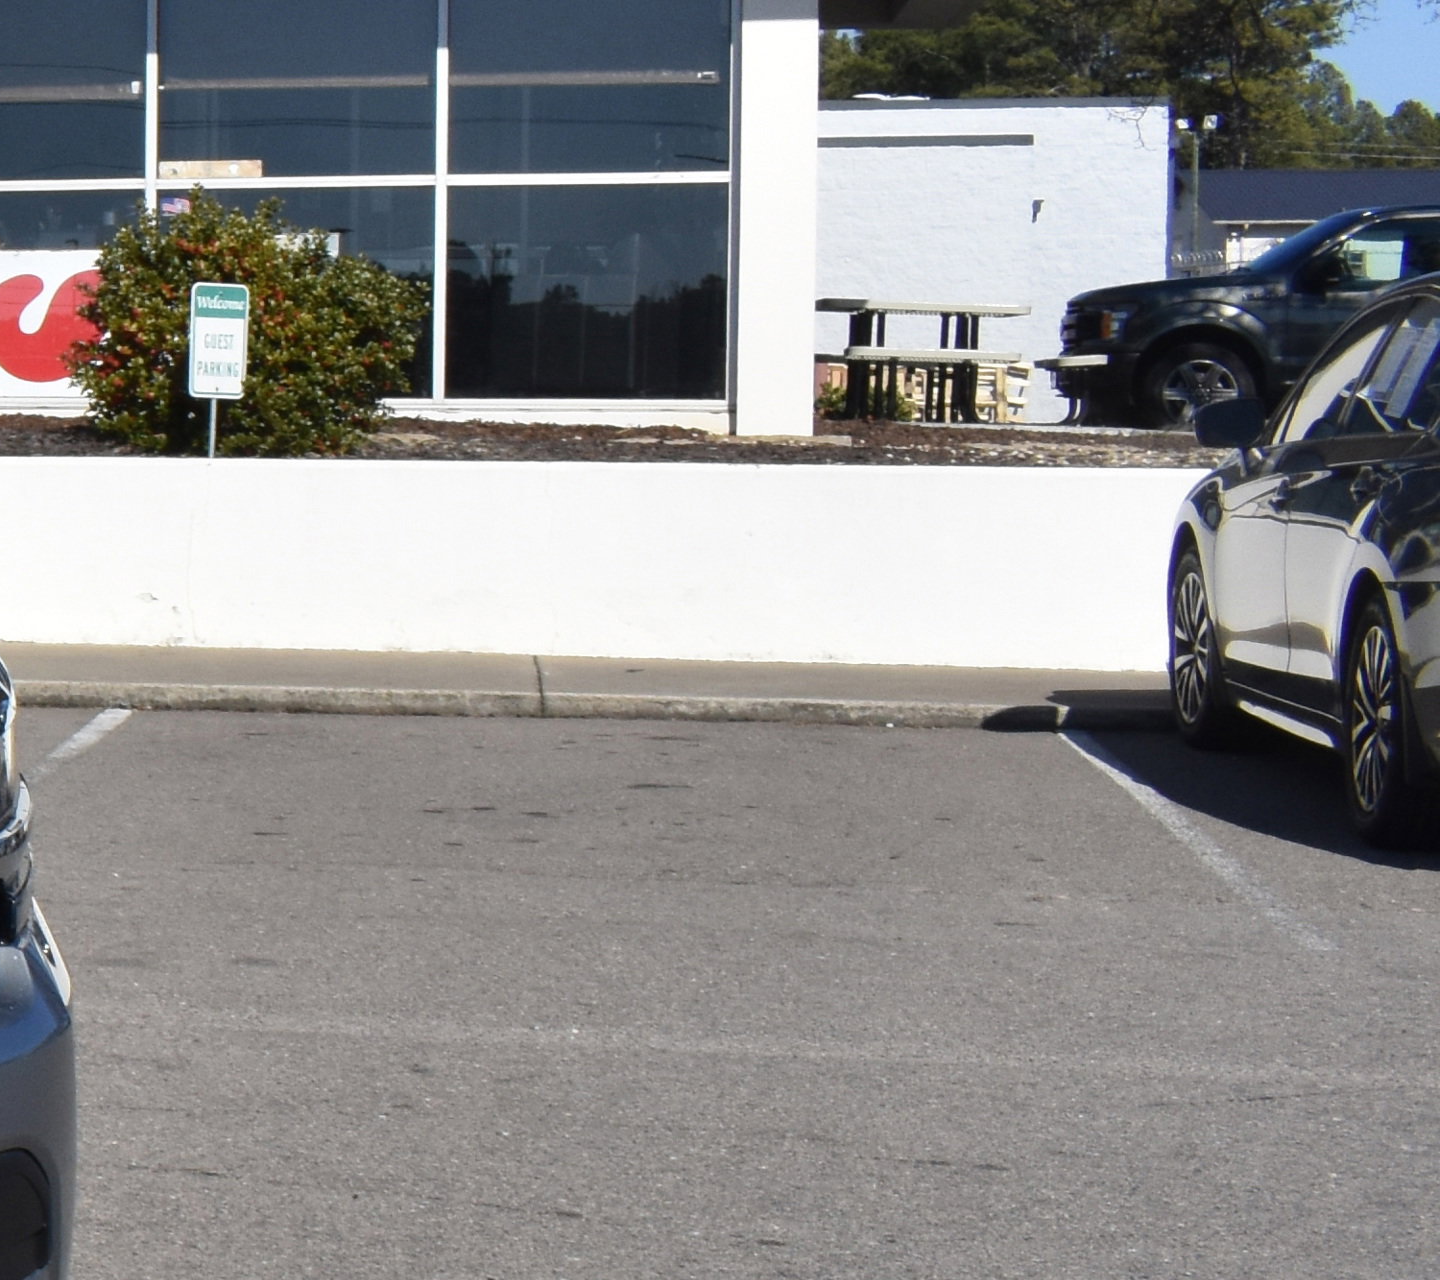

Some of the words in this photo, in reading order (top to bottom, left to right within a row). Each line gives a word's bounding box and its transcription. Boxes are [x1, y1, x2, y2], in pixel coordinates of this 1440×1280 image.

[196, 294, 245, 310] Welcome
[204, 333, 234, 349] GUEST
[196, 360, 240, 377] PARKING
